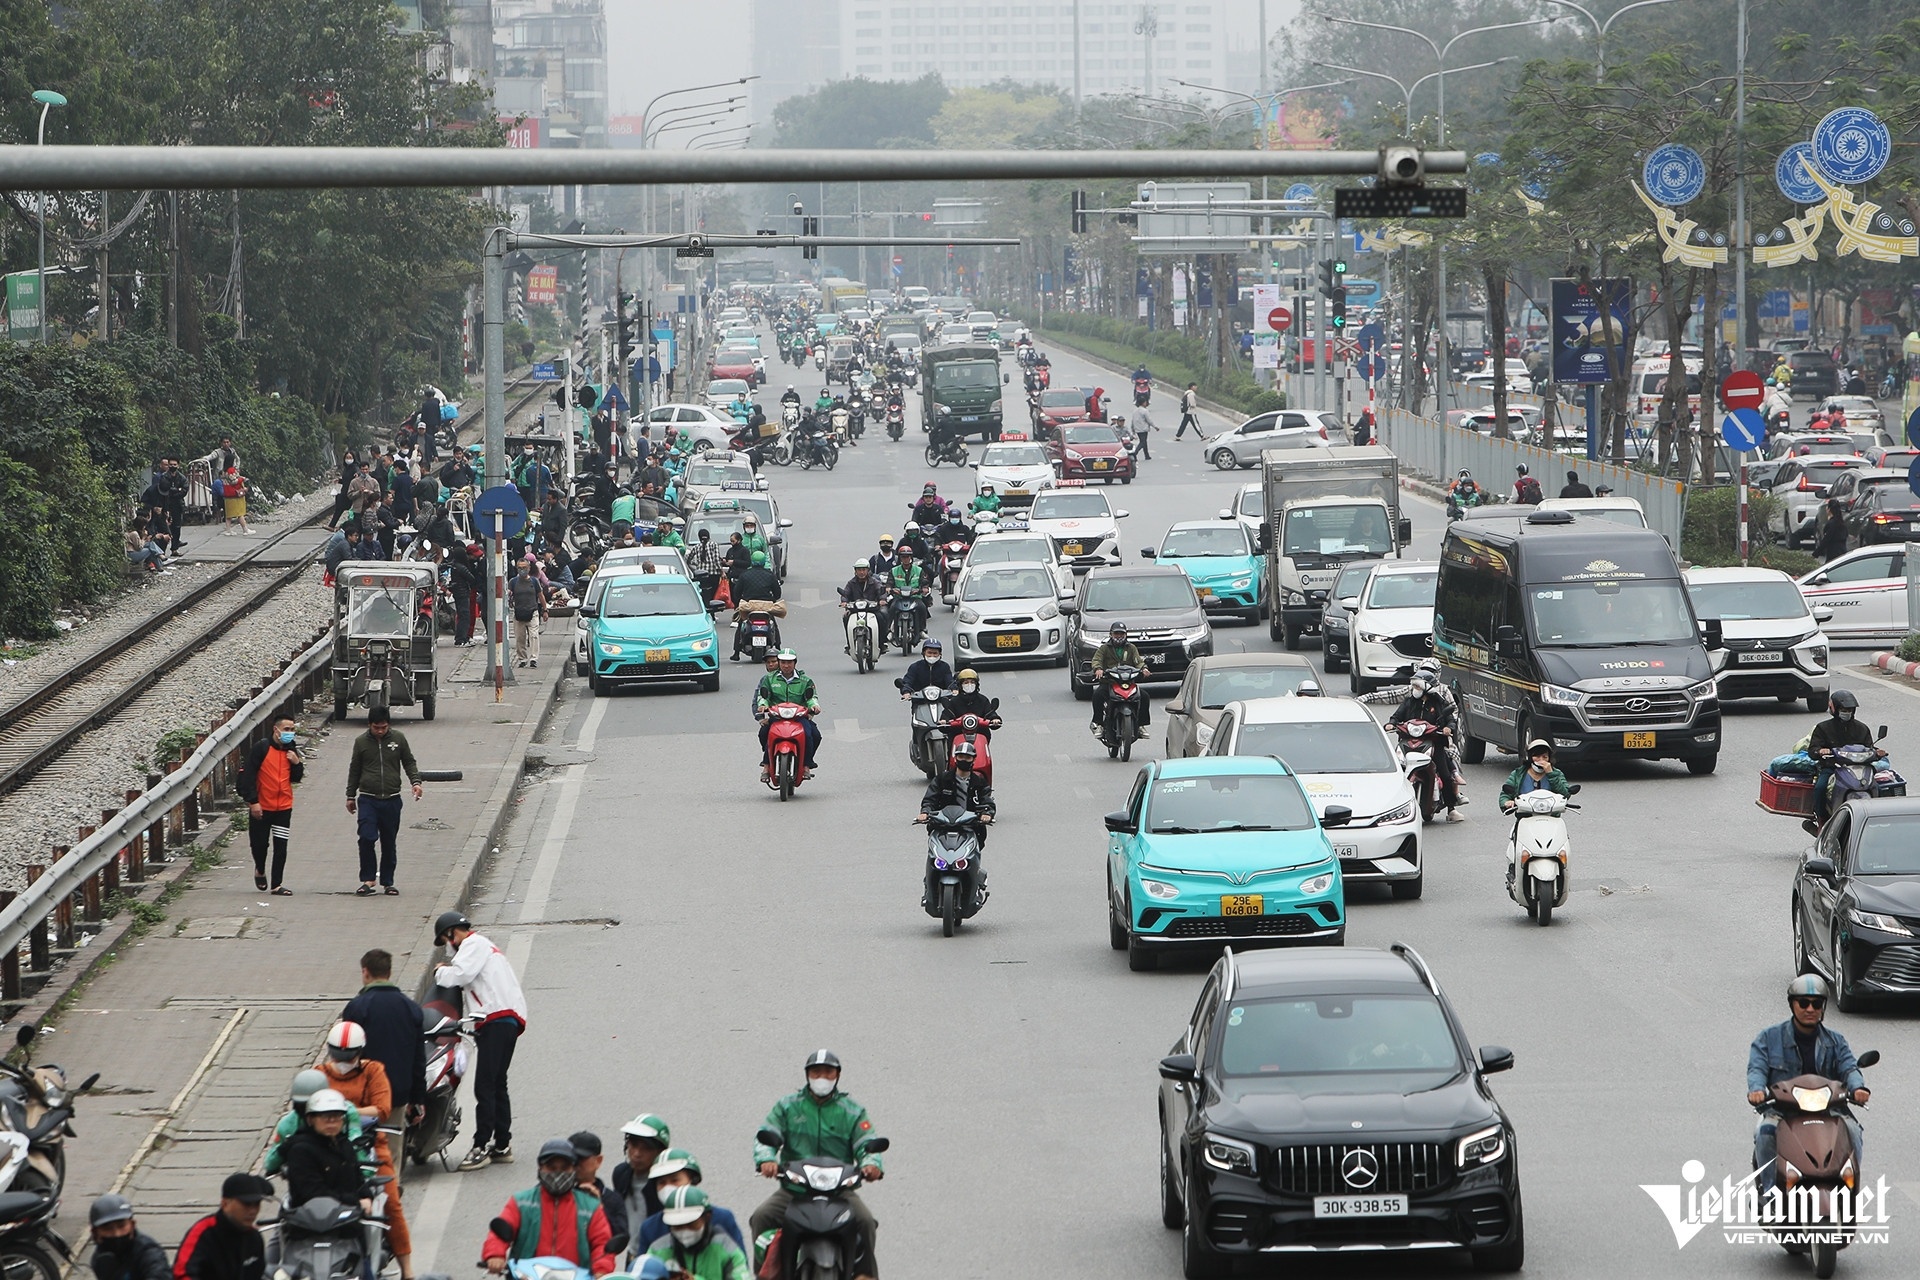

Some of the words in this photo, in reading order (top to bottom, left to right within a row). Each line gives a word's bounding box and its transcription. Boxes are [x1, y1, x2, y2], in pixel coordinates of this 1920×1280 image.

[511, 129, 531, 148] 218
[530, 278, 539, 288] XE
[540, 274, 556, 289] MÁY
[530, 292, 538, 300] XE
[1741, 654, 1780, 662] 36K-026.80
[1600, 661, 1627, 669] THỦ
[1233, 896, 1250, 905] 29E
[1226, 906, 1259, 915] 048.09
[1322, 1200, 1400, 1215] 30K-938.55
